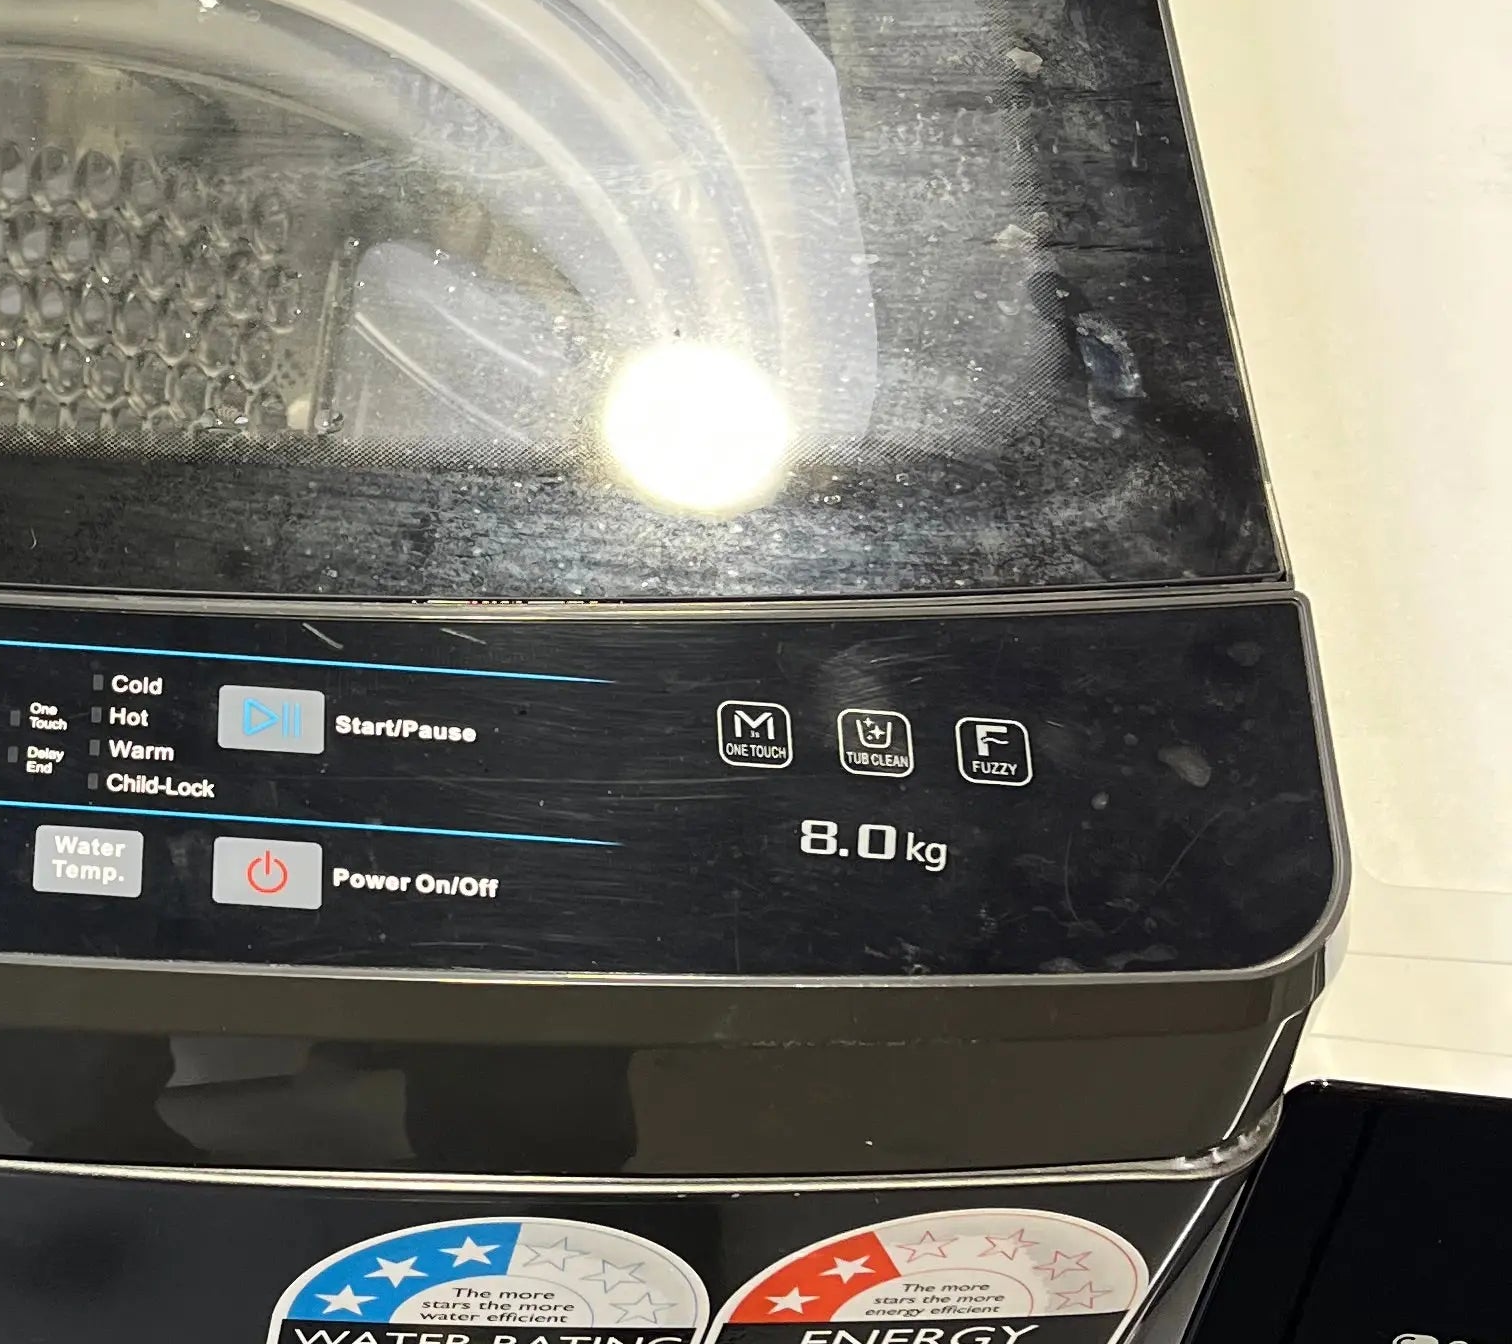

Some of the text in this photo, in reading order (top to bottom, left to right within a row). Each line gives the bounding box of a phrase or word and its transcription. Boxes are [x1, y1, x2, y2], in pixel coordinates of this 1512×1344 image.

[111, 674, 163, 696] Cold
[29, 702, 58, 717] One
[109, 706, 149, 727] Hot
[29, 715, 68, 732] Touch
[335, 714, 478, 743] Start/Pause
[26, 746, 65, 764] Delay
[108, 740, 175, 762] Warm
[725, 742, 787, 760] ONE TOUCH
[846, 750, 909, 769] TUB CLEAN
[26, 759, 53, 775] End
[972, 760, 1018, 776] FUZZY
[106, 773, 215, 798] Child-Lock
[54, 835, 126, 858] Water
[800, 818, 948, 872] 8.0 kg
[52, 859, 125, 885] Temp.
[333, 868, 500, 899] Power On/Off
[454, 1287, 555, 1301] The more
[902, 1282, 990, 1293] The more
[422, 1299, 575, 1313] stars the more
[873, 1293, 1005, 1305] stars the more
[420, 1312, 569, 1325] water efficient
[865, 1304, 1000, 1318] energy efficient
